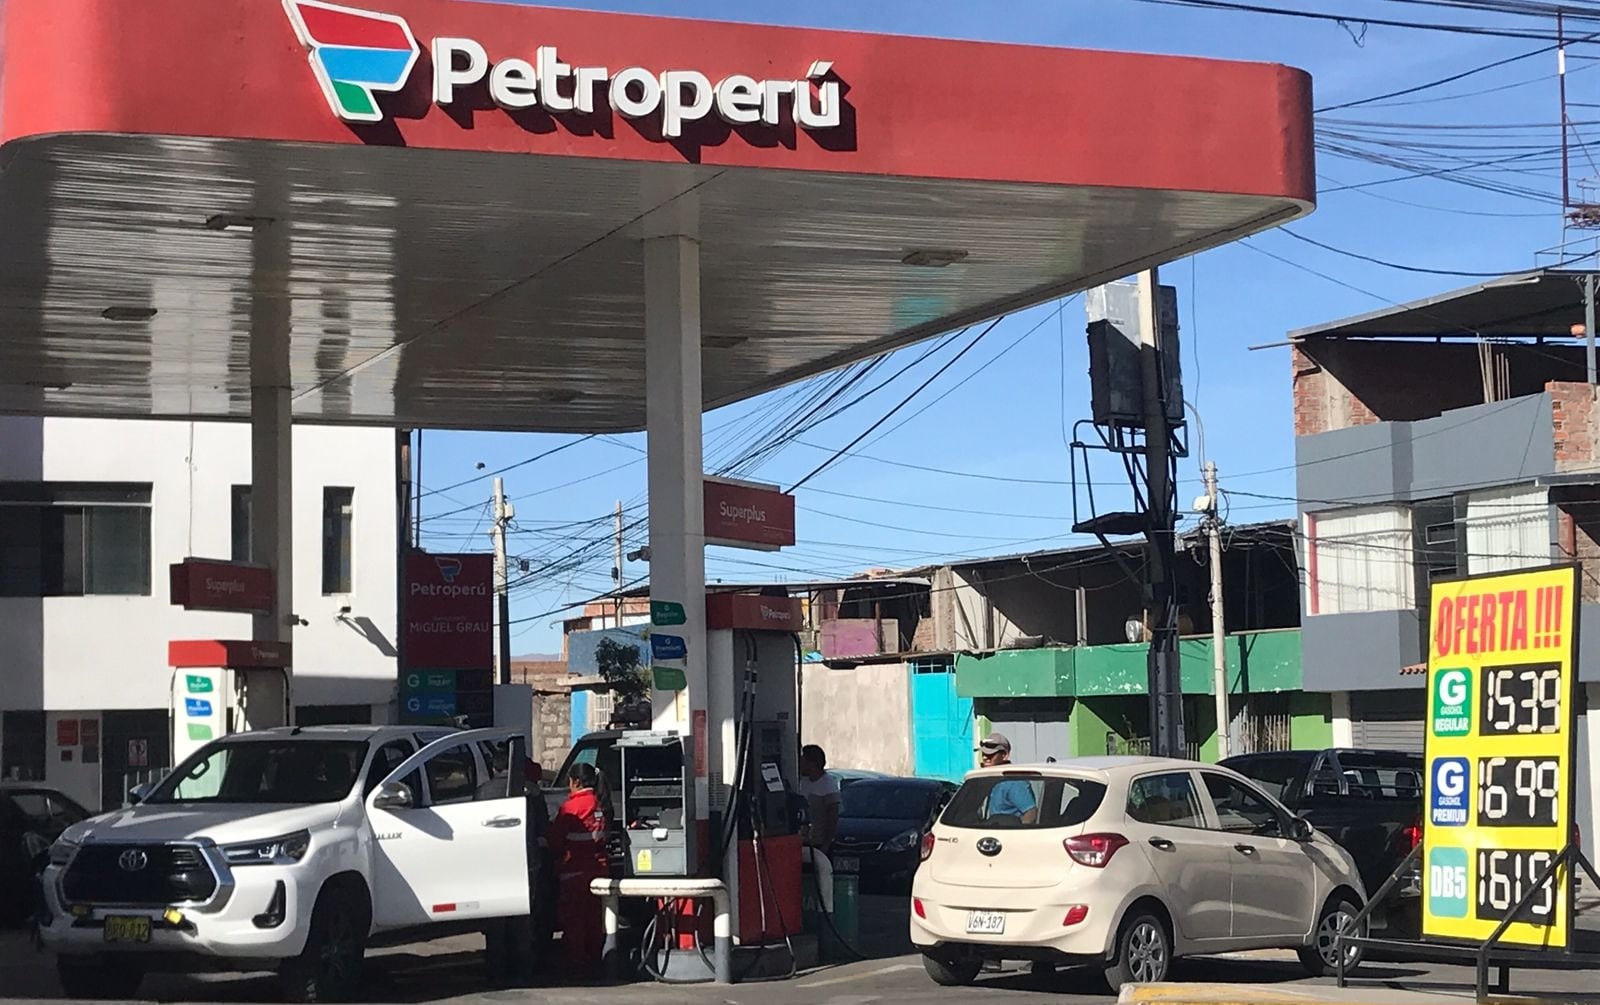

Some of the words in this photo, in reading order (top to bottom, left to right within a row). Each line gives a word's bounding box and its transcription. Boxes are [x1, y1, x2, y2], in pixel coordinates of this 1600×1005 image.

[431, 36, 840, 138] Petroperú
[719, 501, 766, 523] Superplus
[411, 582, 486, 598] Petroperú
[456, 621, 489, 633] GRAU
[1437, 590, 1528, 657] OFERTA
[407, 674, 420, 687] G
[1439, 671, 1467, 706] G
[407, 698, 420, 711] G
[1435, 717, 1469, 732] REGULAR
[1437, 761, 1464, 796] G
[1433, 808, 1467, 822] PREMIUM
[1430, 865, 1467, 899] DB5
